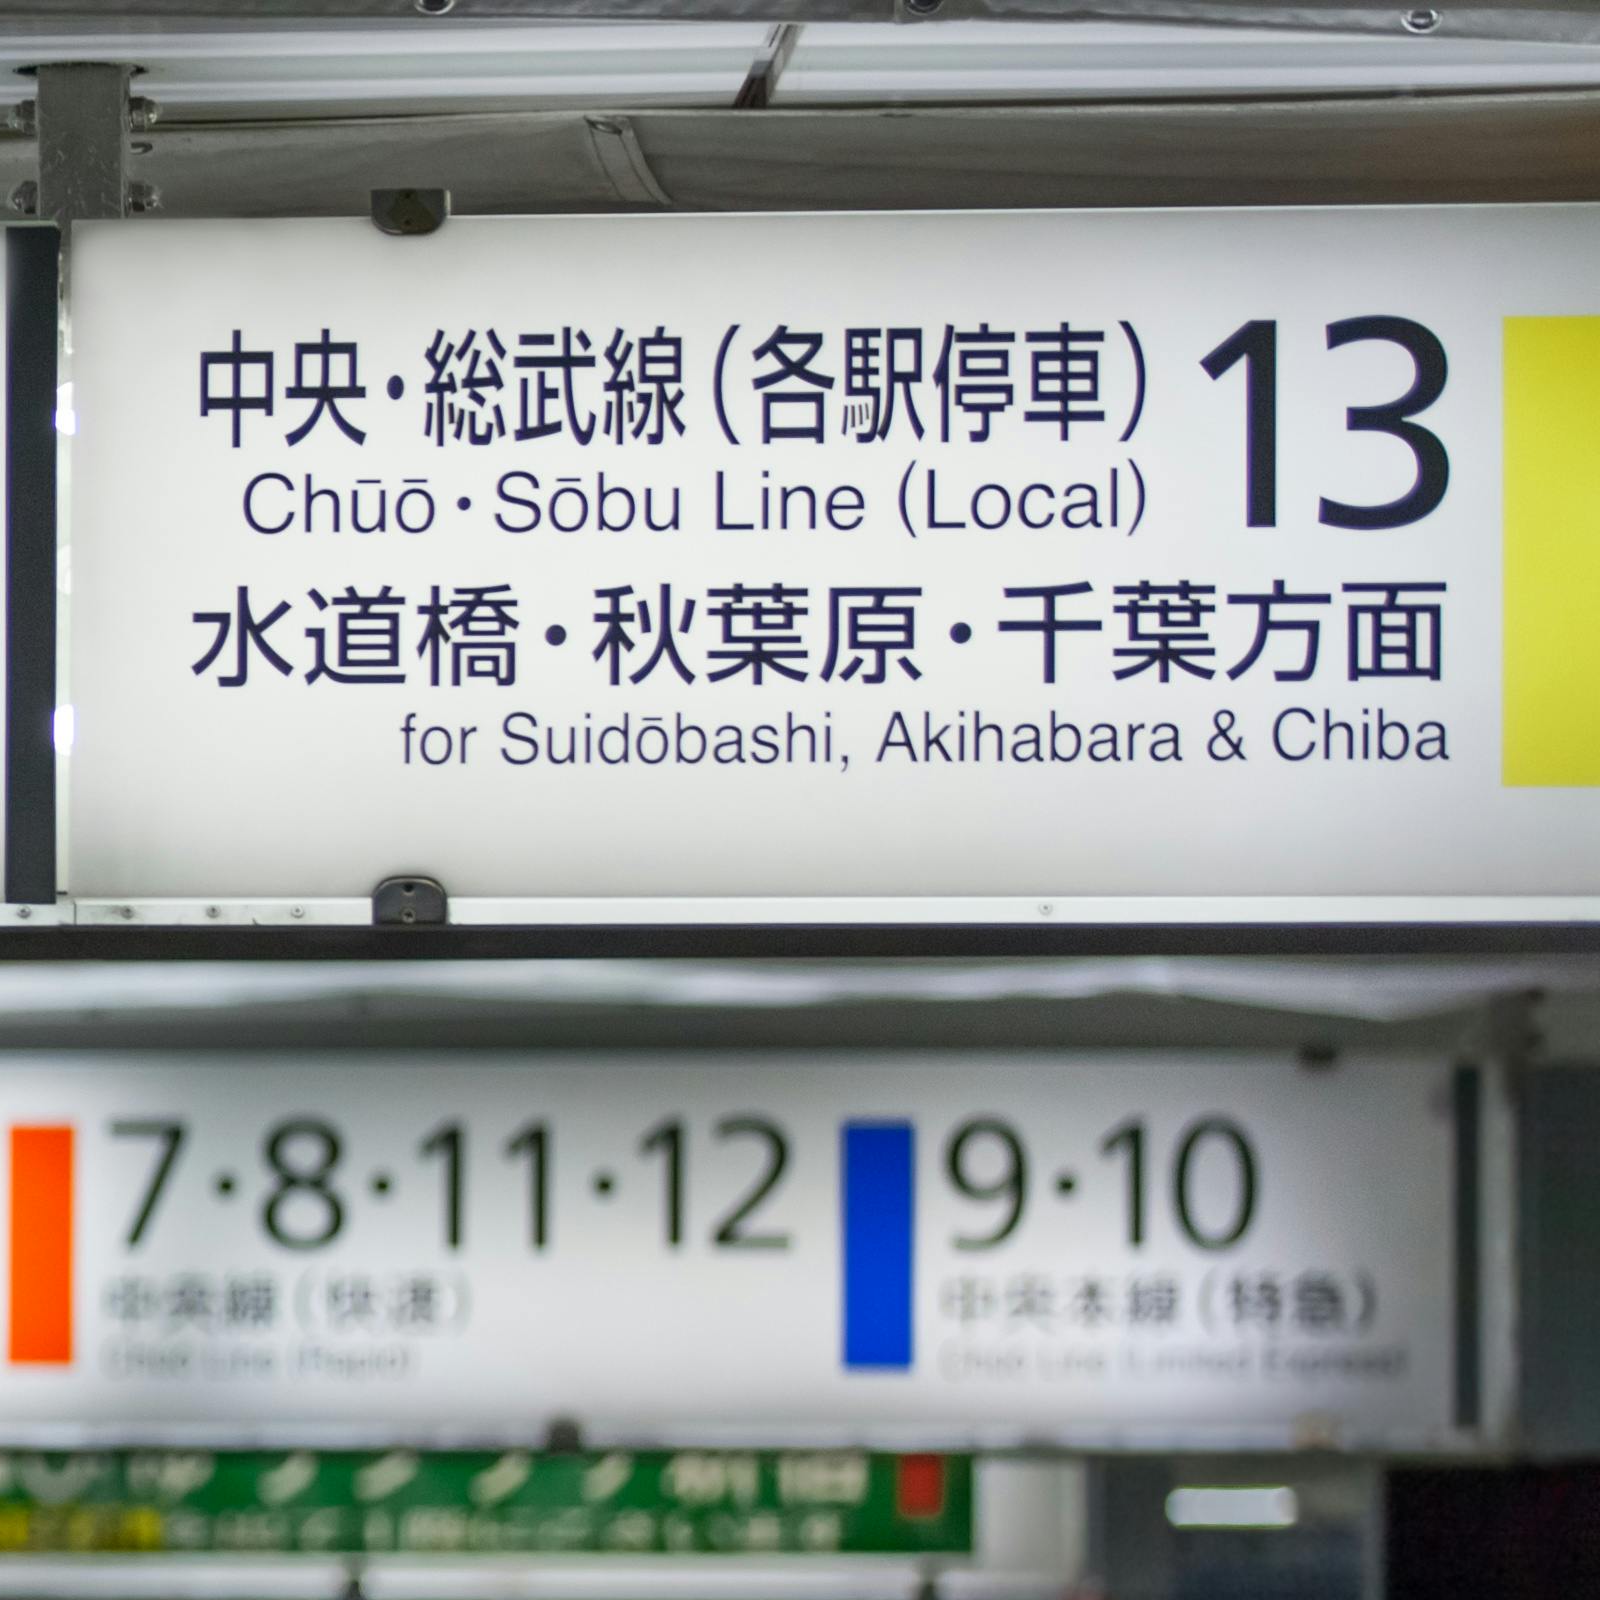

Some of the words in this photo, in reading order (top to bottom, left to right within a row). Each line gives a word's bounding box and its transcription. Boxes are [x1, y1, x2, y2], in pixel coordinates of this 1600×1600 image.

[200, 320, 1147, 449] 中央・総武線（各駅停車）
[1199, 314, 1450, 531] 13
[716, 470, 865, 531] Line
[898, 458, 1146, 538] (Local)
[191, 579, 1447, 688] 水道橋・秋葉原・千葉方面
[400, 712, 478, 766] for
[501, 711, 849, 772] Suidōbashi,
[876, 709, 1183, 763] Akihabara
[1207, 709, 1247, 762] &
[1272, 707, 1450, 762] Chiba
